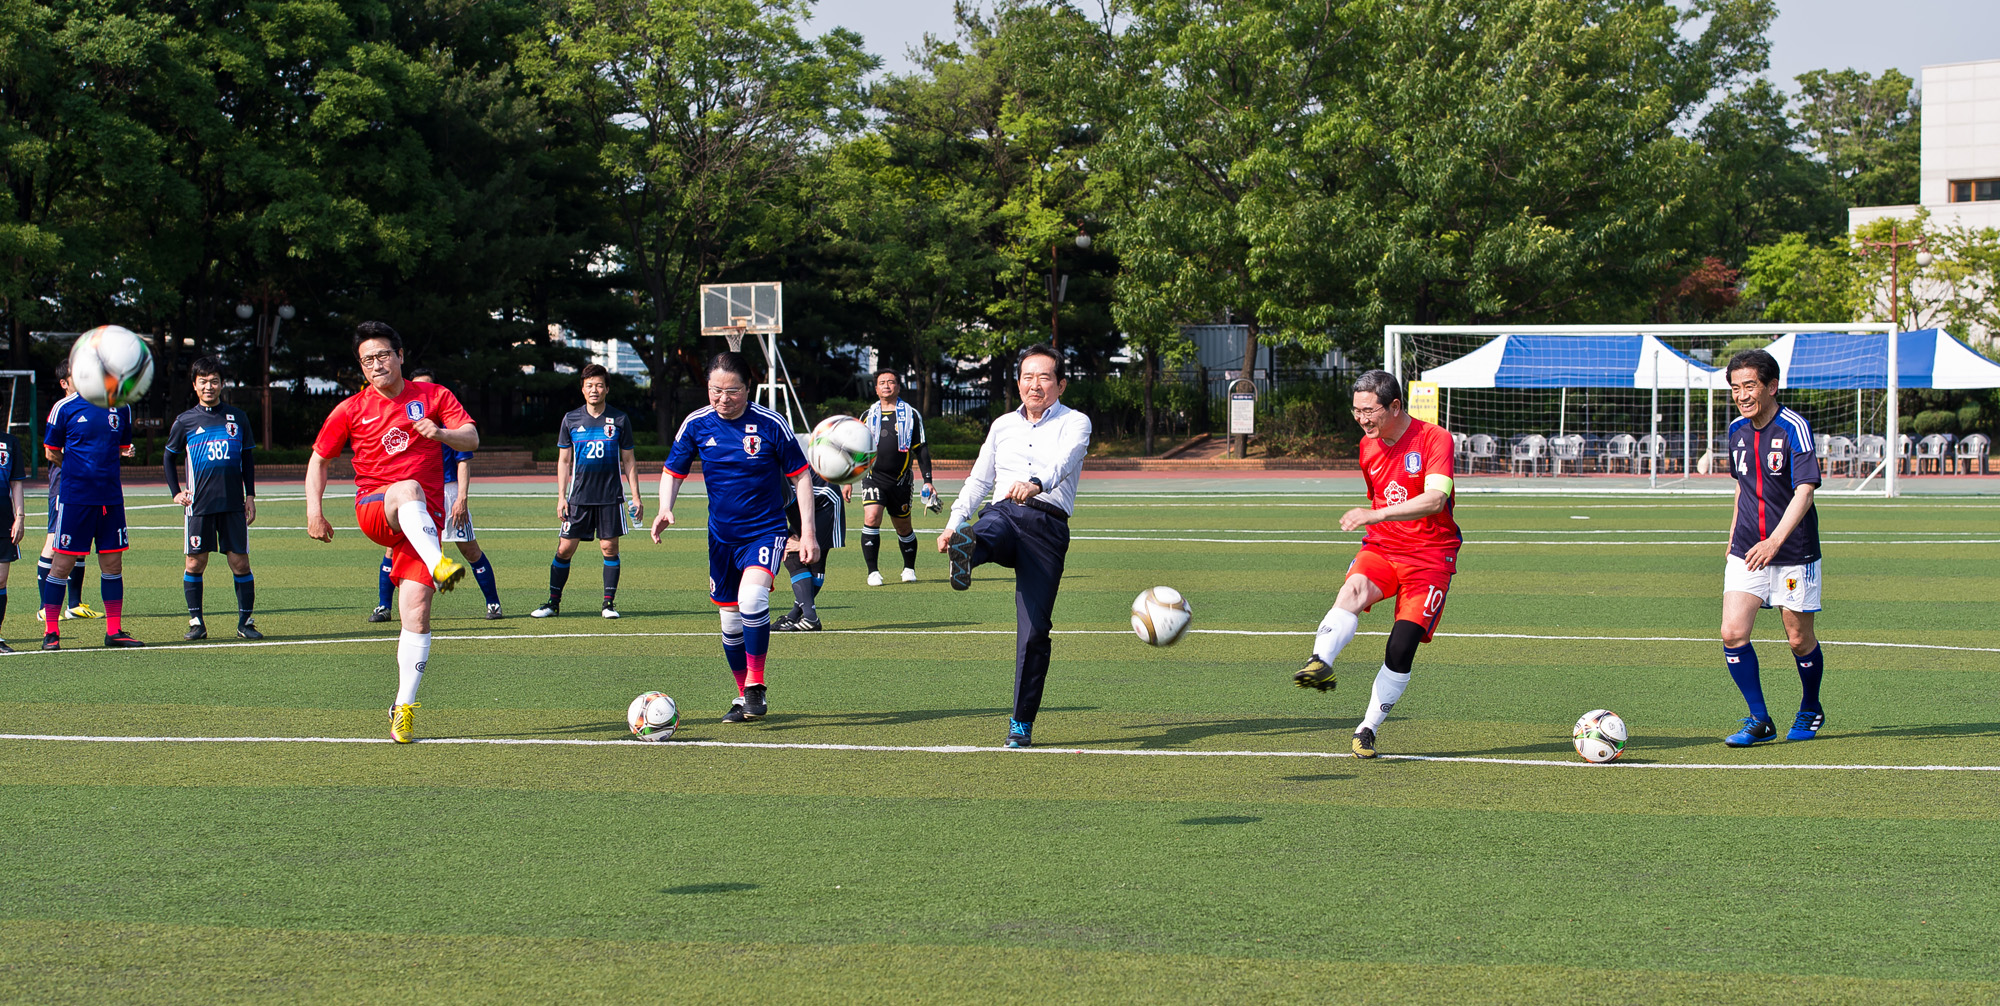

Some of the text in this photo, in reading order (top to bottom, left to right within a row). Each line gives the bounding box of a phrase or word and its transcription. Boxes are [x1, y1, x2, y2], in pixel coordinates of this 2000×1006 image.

[207, 440, 230, 460] 382
[586, 440, 605, 459] 28
[1732, 450, 1748, 476] 14
[117, 527, 128, 546] 13
[457, 524, 466, 538] 8
[758, 546, 770, 565] 8
[1423, 584, 1443, 613] 10
